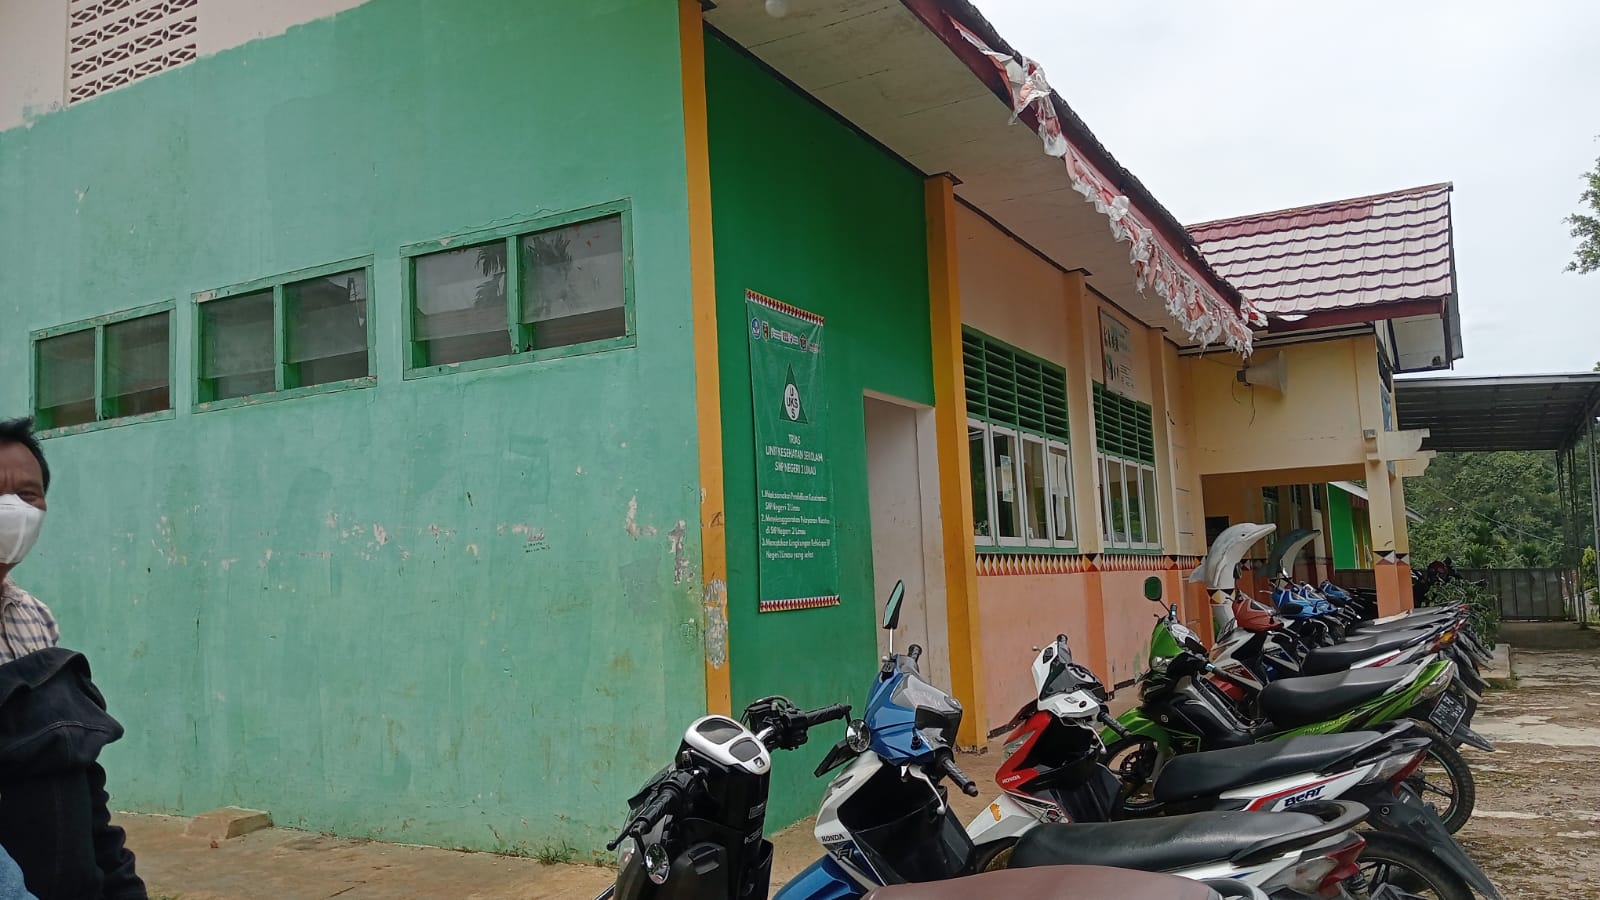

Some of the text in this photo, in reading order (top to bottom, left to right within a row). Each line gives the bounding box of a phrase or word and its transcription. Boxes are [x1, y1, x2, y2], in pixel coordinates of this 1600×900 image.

[787, 397, 798, 408] UKS
[791, 409, 795, 418] S
[1001, 774, 1021, 785] HONDA
[821, 833, 845, 842] HONDA
